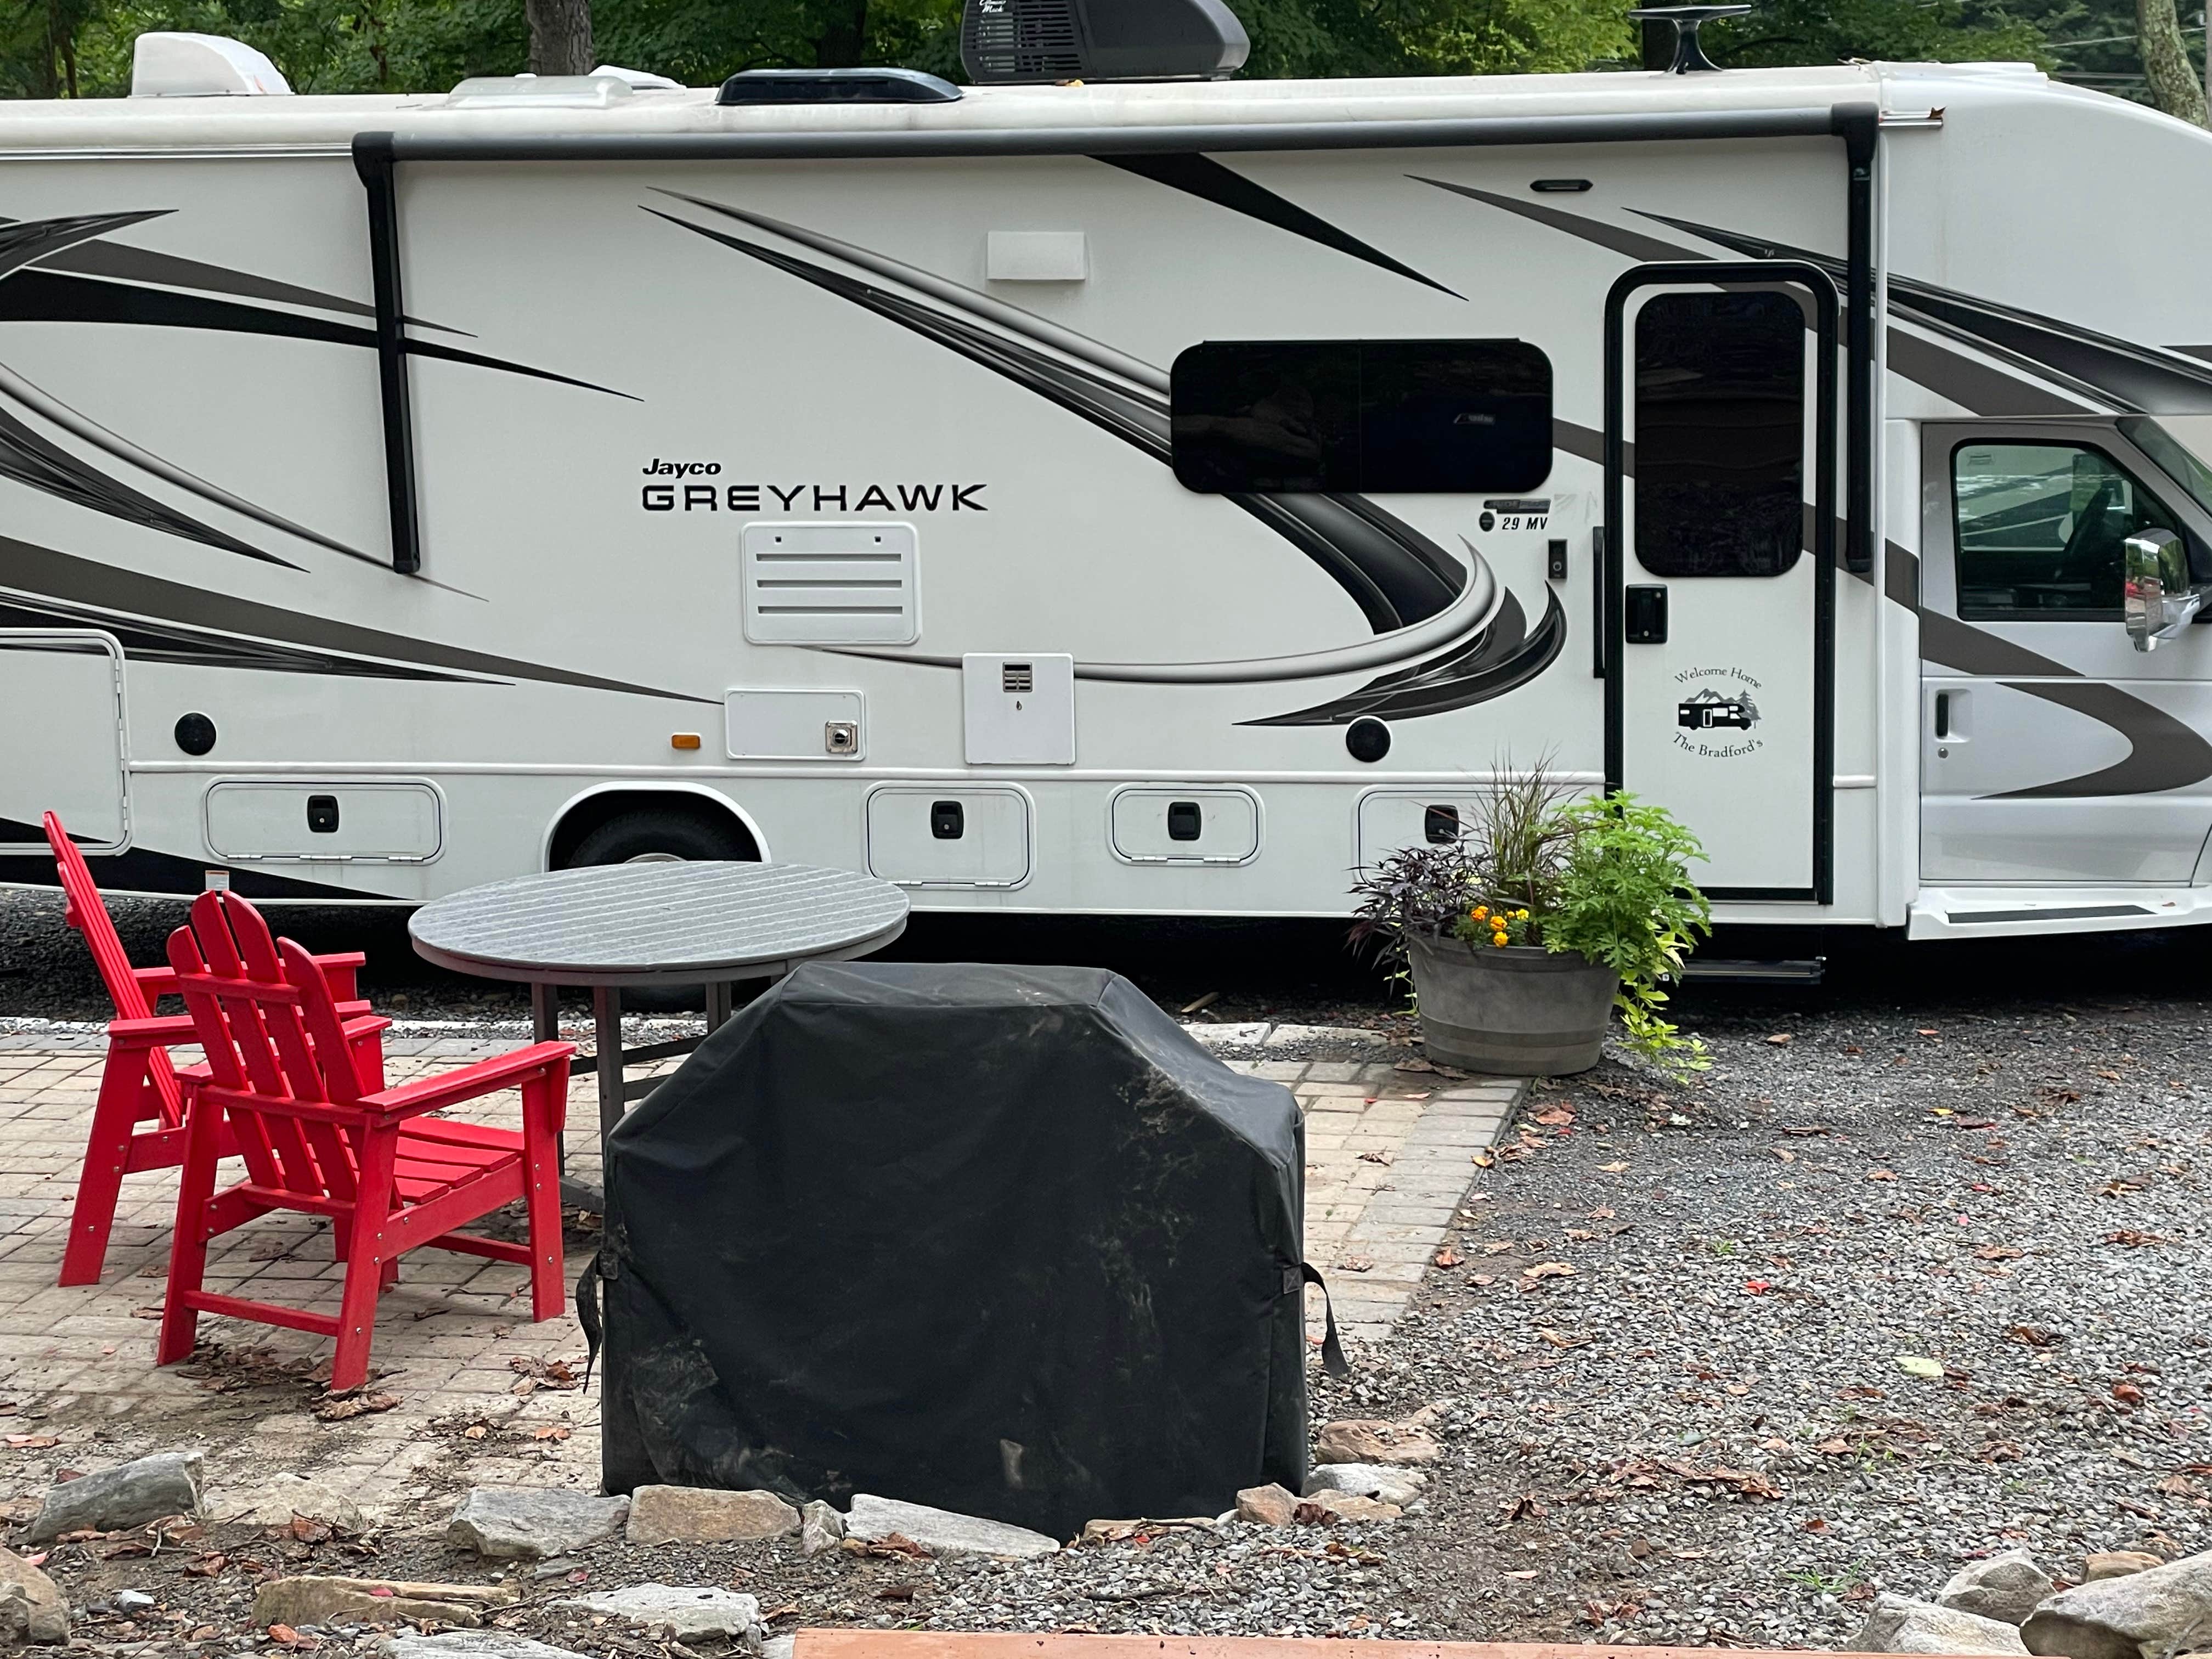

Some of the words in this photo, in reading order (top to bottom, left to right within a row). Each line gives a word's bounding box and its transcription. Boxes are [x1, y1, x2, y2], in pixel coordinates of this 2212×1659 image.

[642, 458, 721, 479] Jayco
[642, 484, 988, 511] GREYHAWK
[1502, 517, 1520, 530] 29
[1526, 517, 1548, 530] MV
[1674, 667, 1728, 684] Welcome
[1730, 667, 1762, 690] Home
[1673, 731, 1695, 753] The
[1699, 739, 1764, 758] Bradford's
